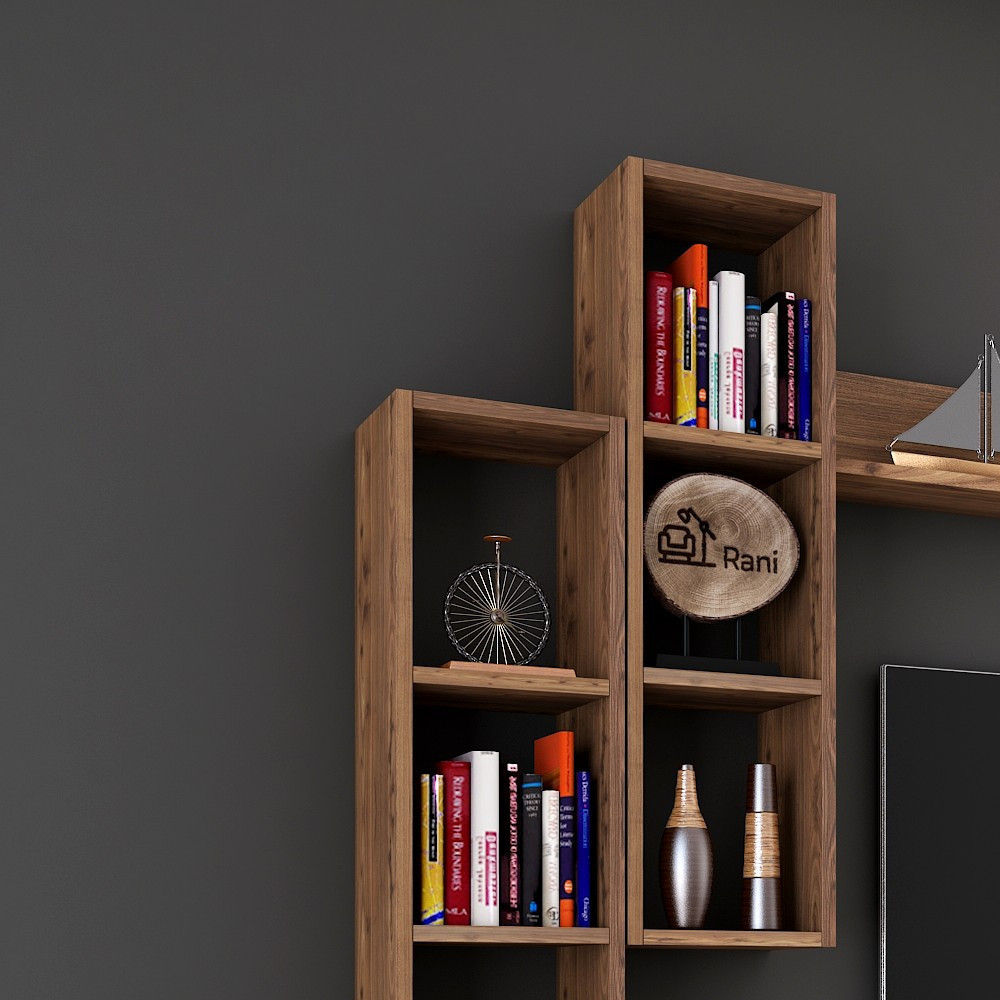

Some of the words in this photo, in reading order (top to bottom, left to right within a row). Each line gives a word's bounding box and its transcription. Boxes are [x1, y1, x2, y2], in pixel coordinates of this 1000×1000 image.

[656, 286, 667, 330] REDRAWING
[656, 332, 665, 347] THE
[656, 349, 667, 396] BOUNDARIES
[724, 546, 778, 574] Rani
[452, 776, 464, 822] REDRAWING
[453, 824, 462, 840] THE
[452, 842, 464, 891] BOUNDARIES
[582, 896, 590, 922] Chicago
